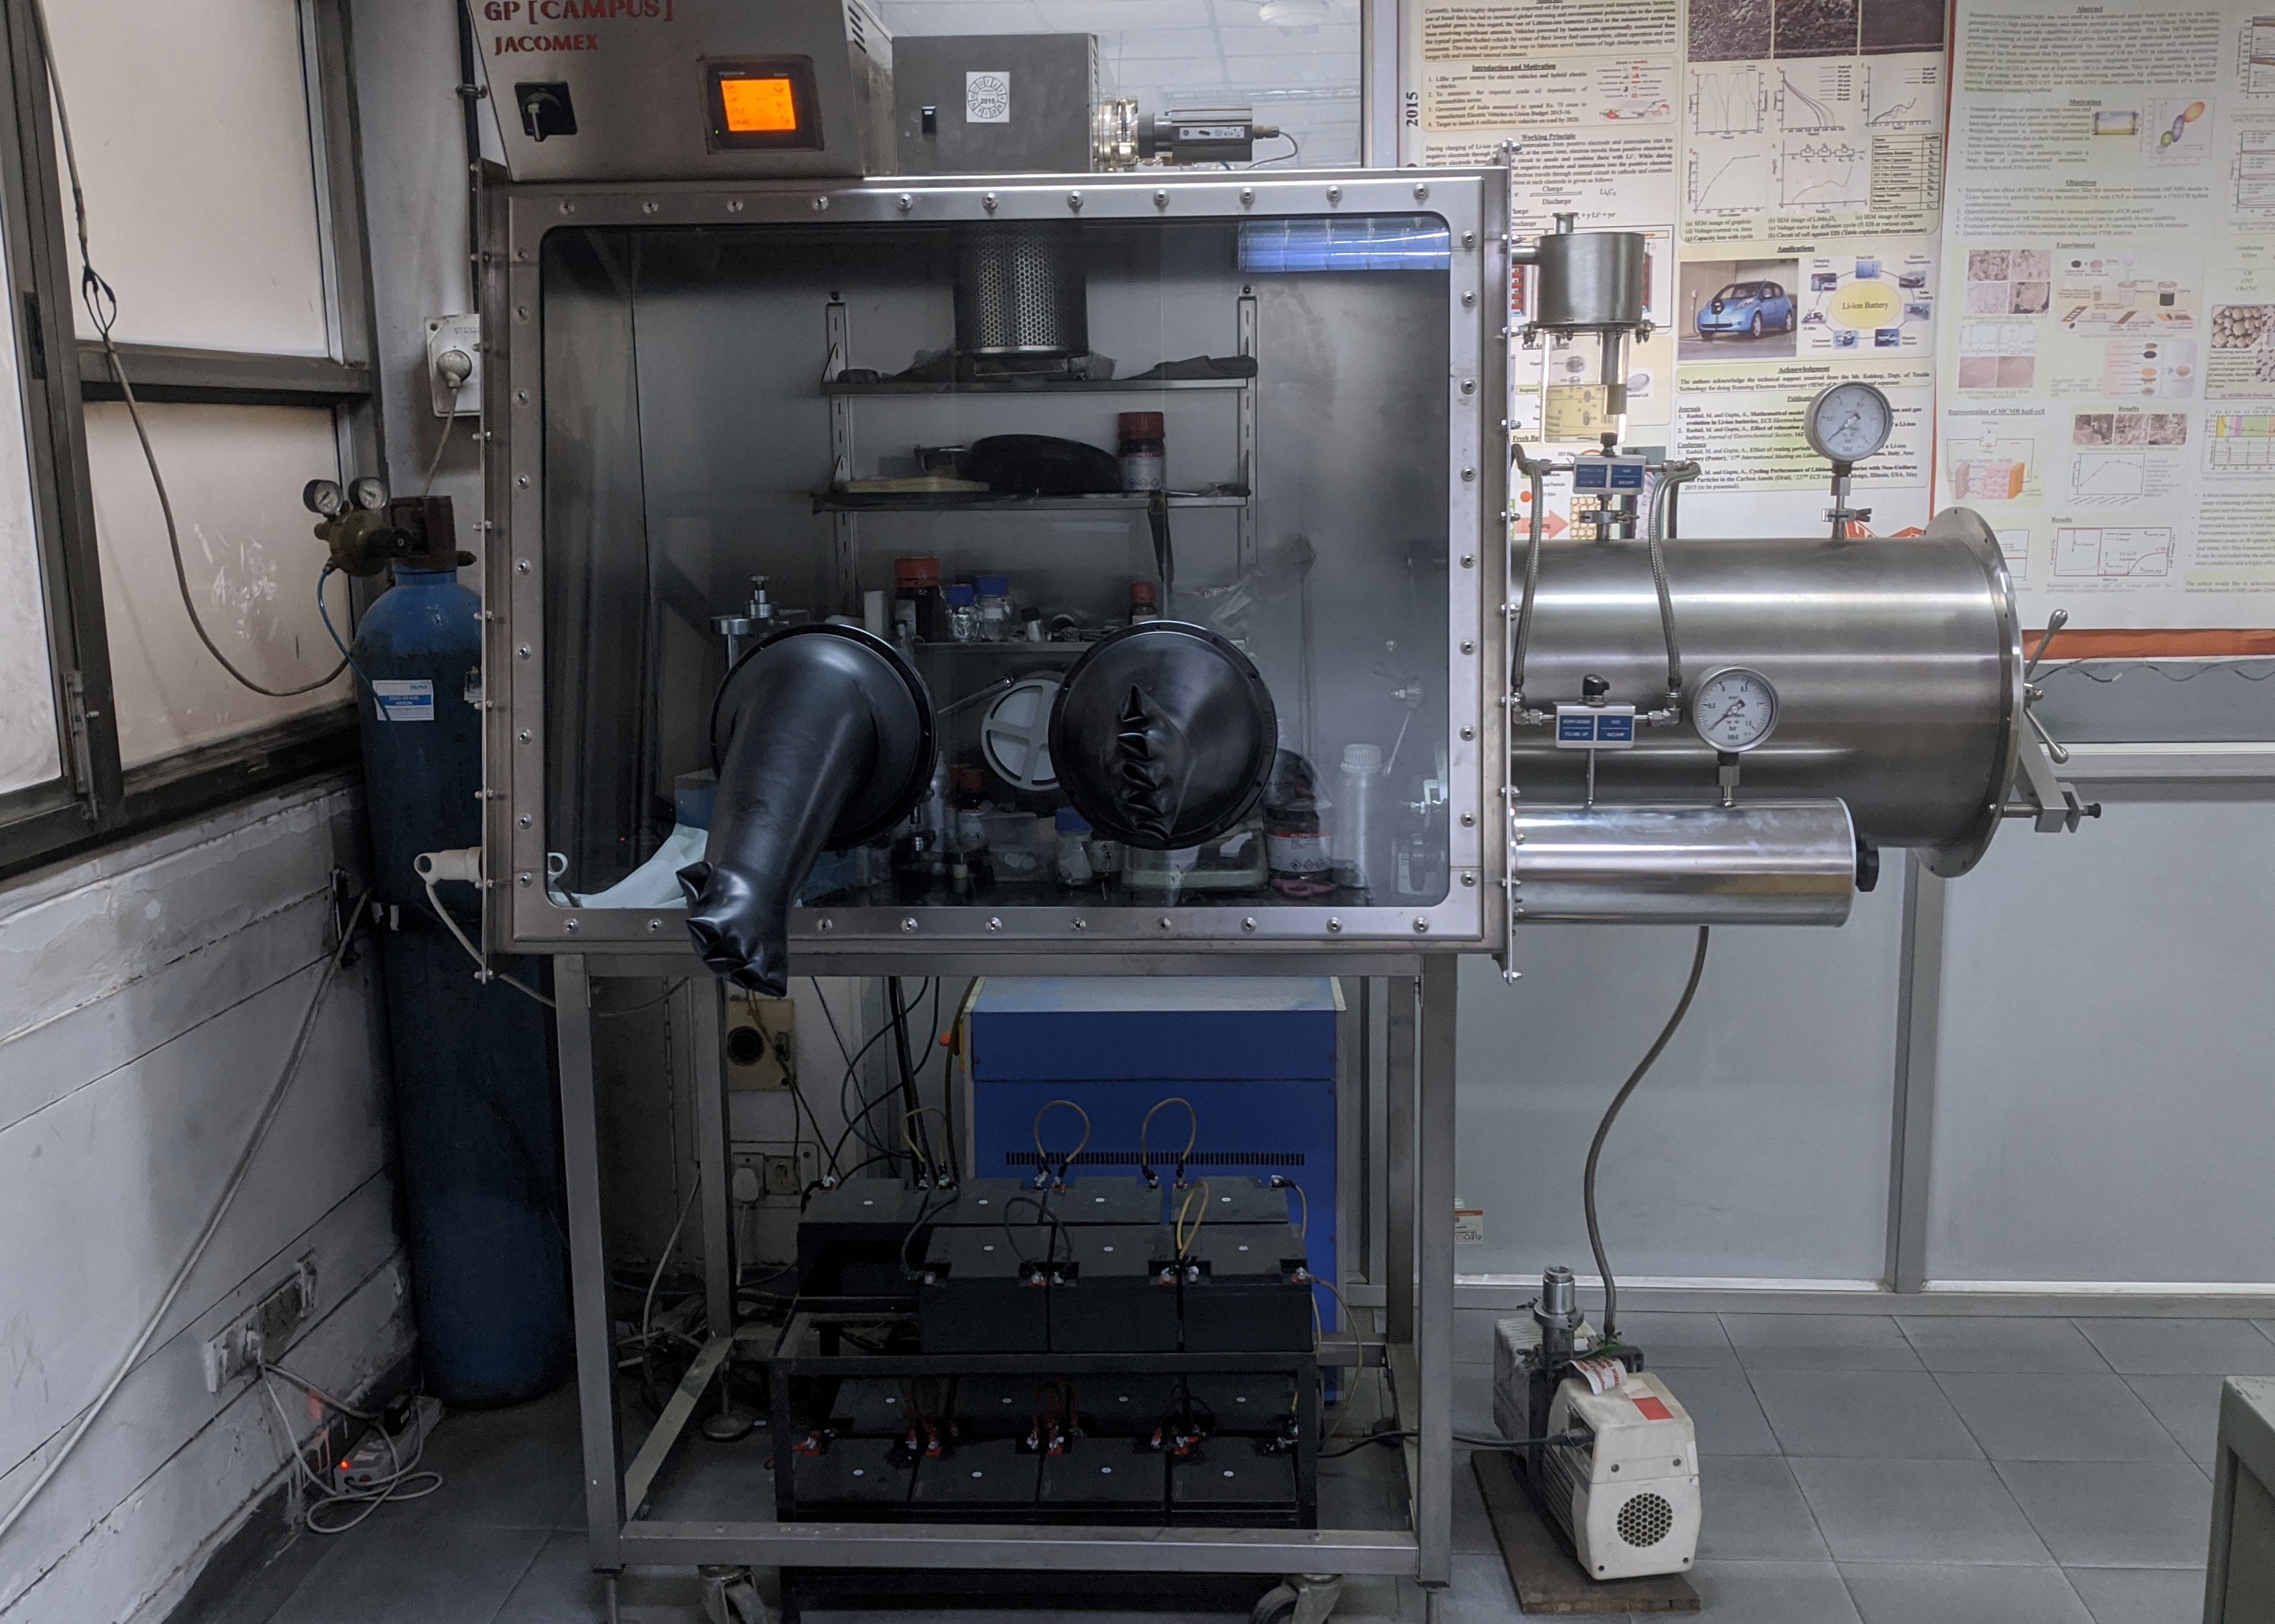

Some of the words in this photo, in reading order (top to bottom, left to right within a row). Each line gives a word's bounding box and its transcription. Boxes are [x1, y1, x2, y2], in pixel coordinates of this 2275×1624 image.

[484, 1, 520, 21] GP
[494, 34, 598, 55] JACOMEX
[1406, 92, 1419, 128] 2015
[1865, 301, 1888, 310] Battery
